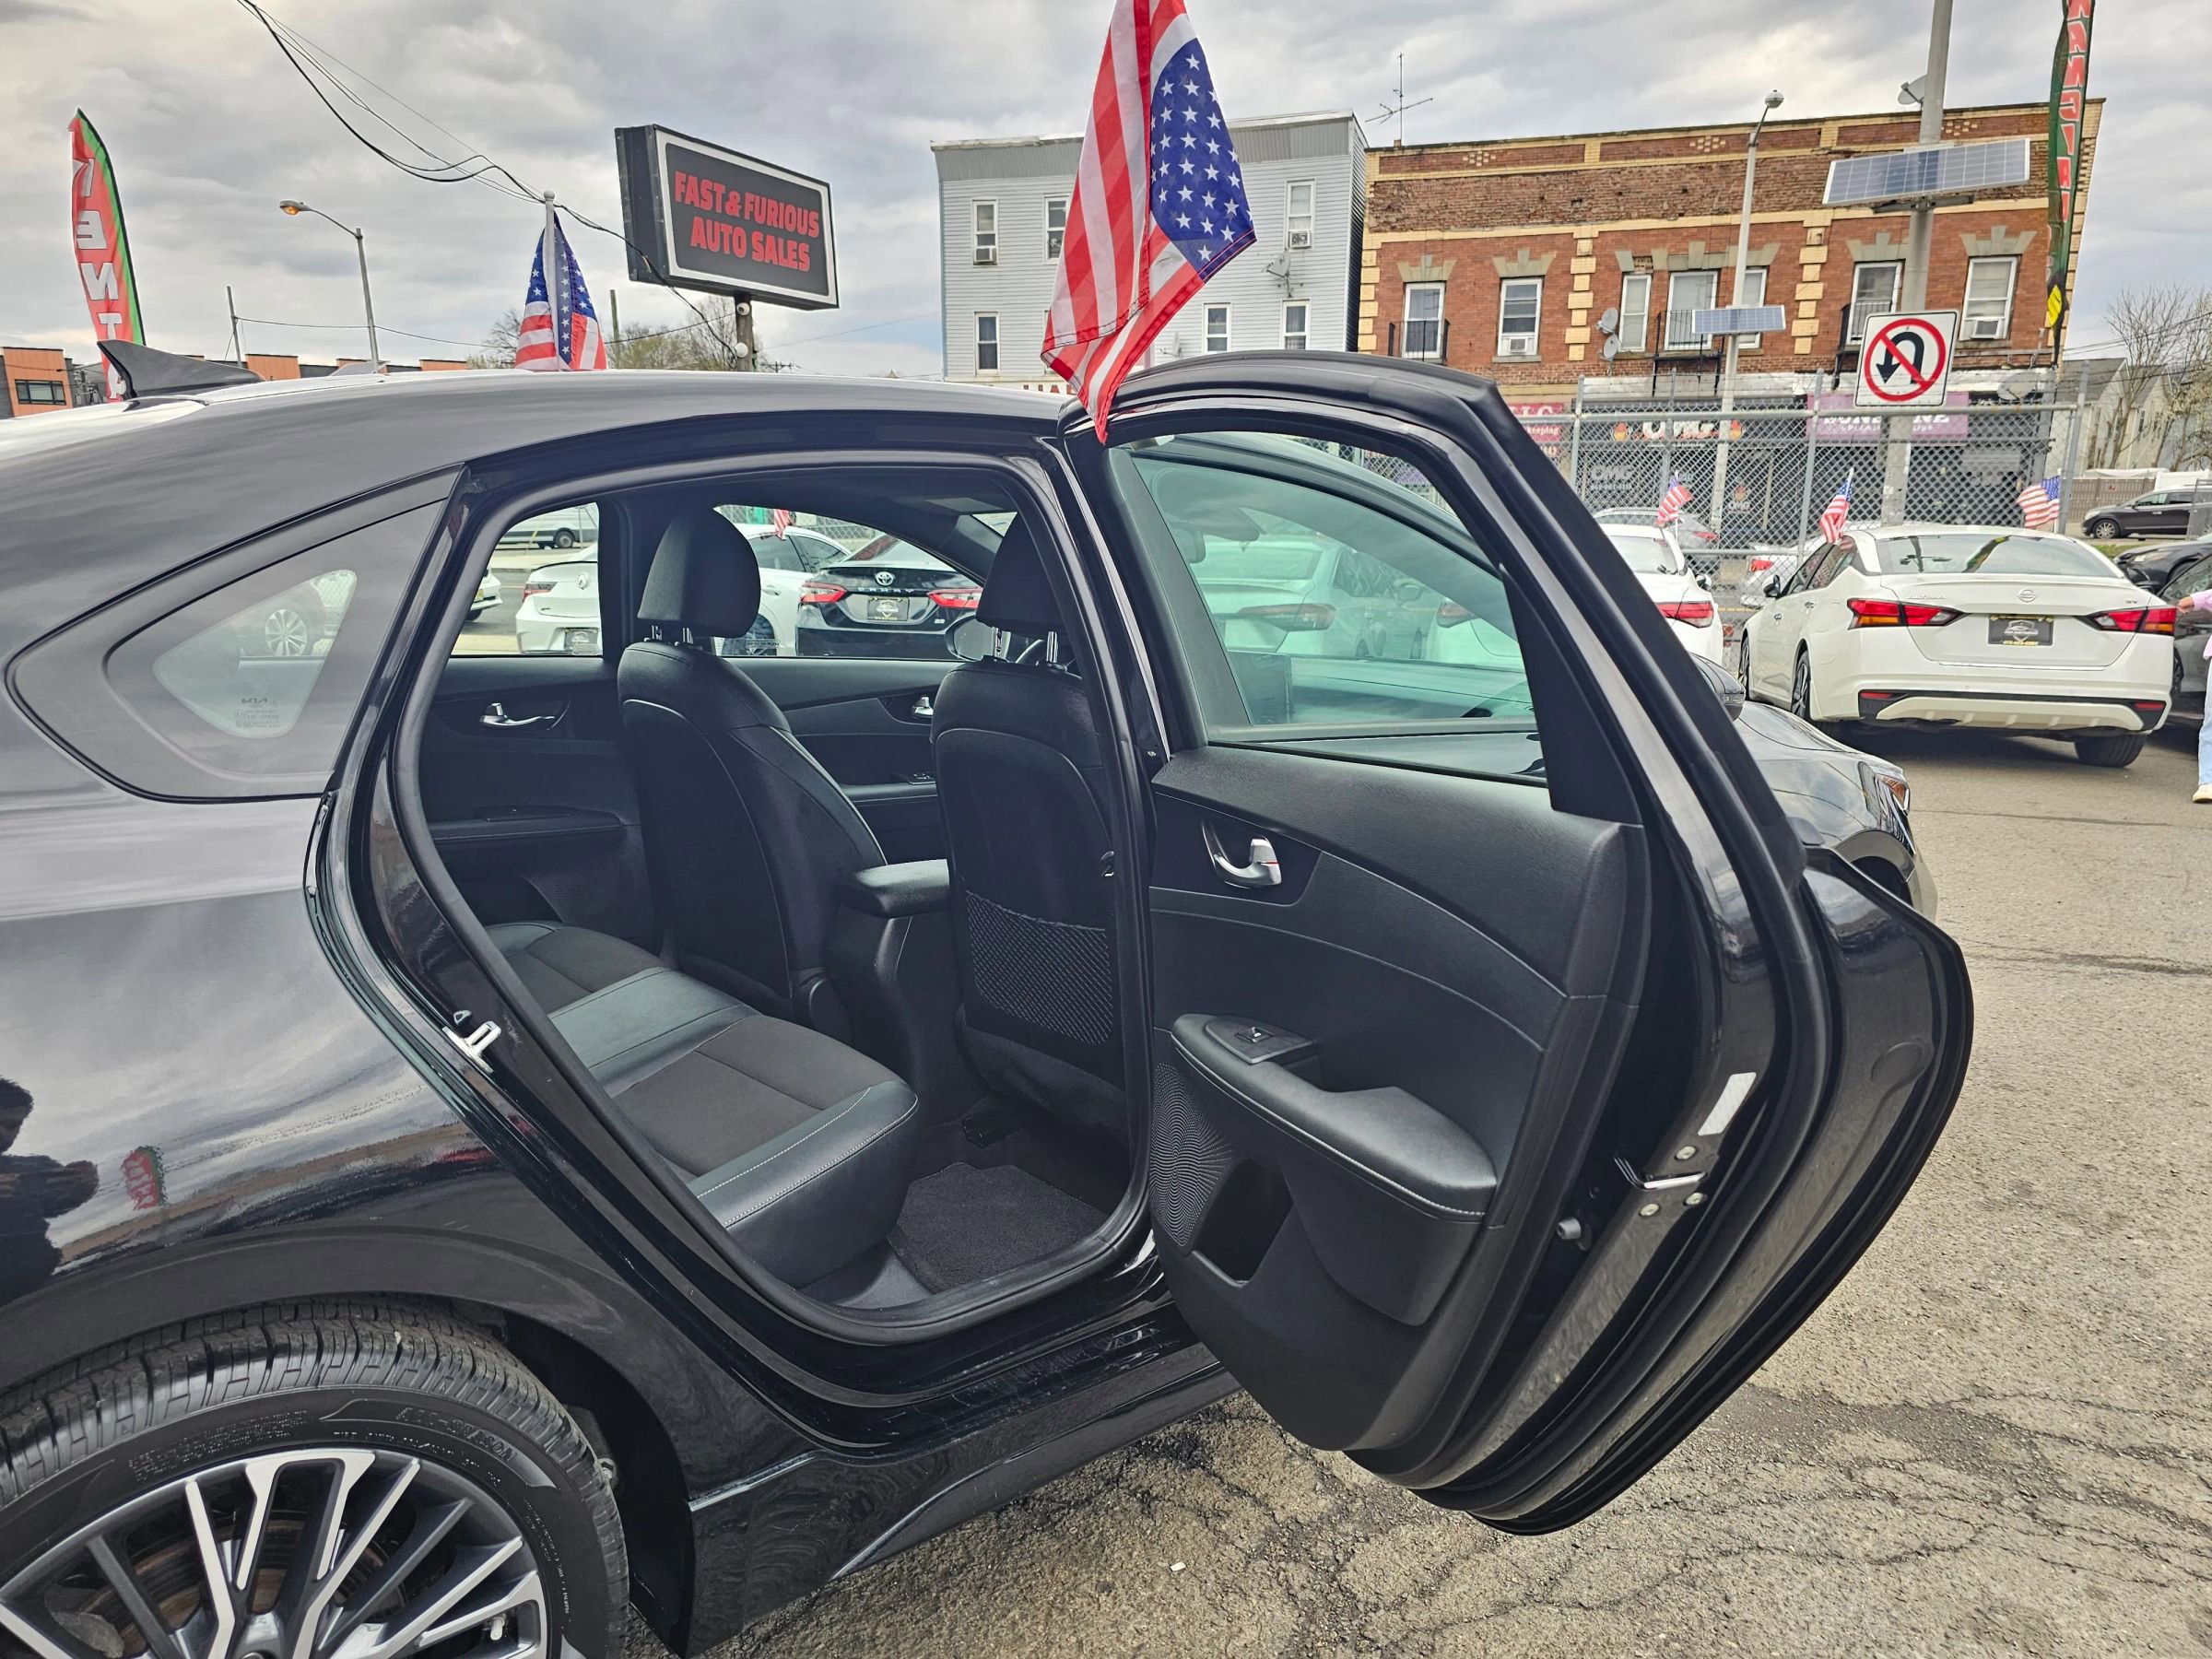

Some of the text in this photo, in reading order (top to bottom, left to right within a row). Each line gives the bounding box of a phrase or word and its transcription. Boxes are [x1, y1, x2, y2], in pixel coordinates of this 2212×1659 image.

[675, 171, 725, 213] FAST
[744, 192, 819, 238] FURIOUS
[690, 217, 810, 272] AUTO SALES
